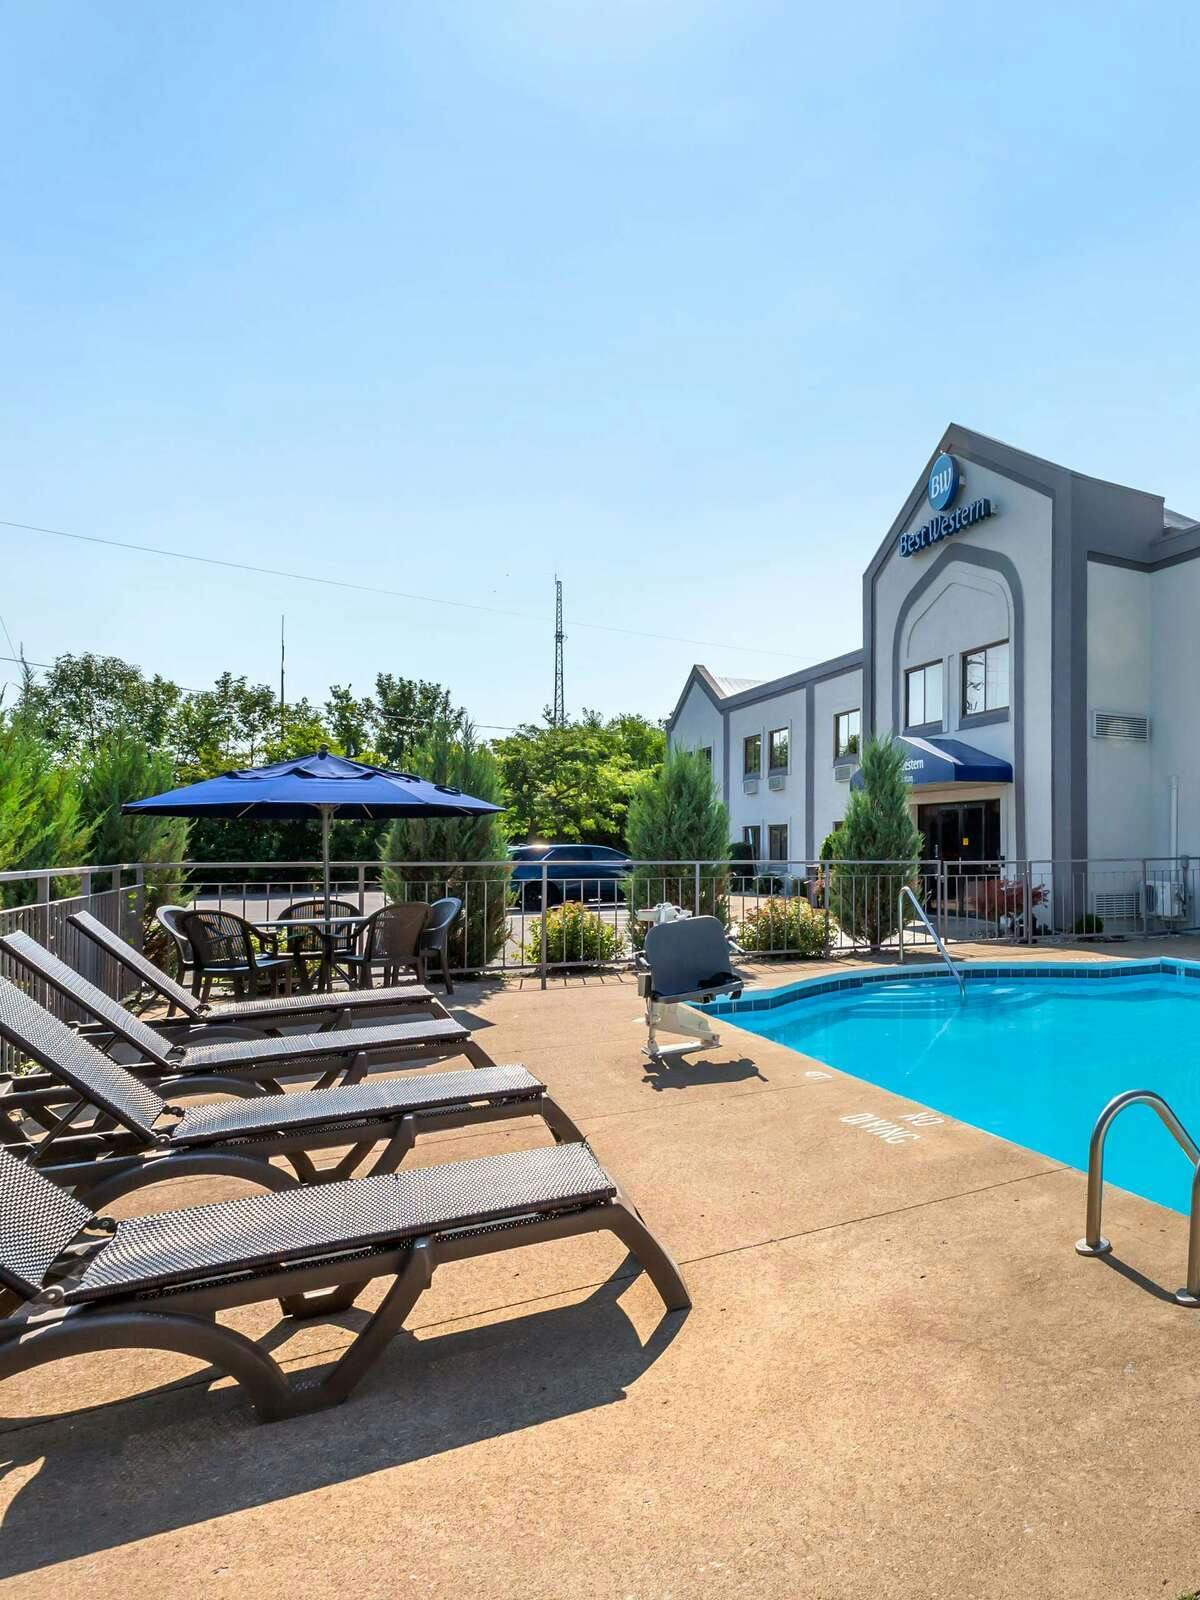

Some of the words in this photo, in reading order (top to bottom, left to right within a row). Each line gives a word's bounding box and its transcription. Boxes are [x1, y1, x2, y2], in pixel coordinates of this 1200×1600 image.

[931, 467, 951, 499] BW
[899, 525, 927, 557] Best
[929, 497, 986, 542] Western
[839, 1112, 921, 1144] DIVING
[897, 1112, 945, 1127] NO
